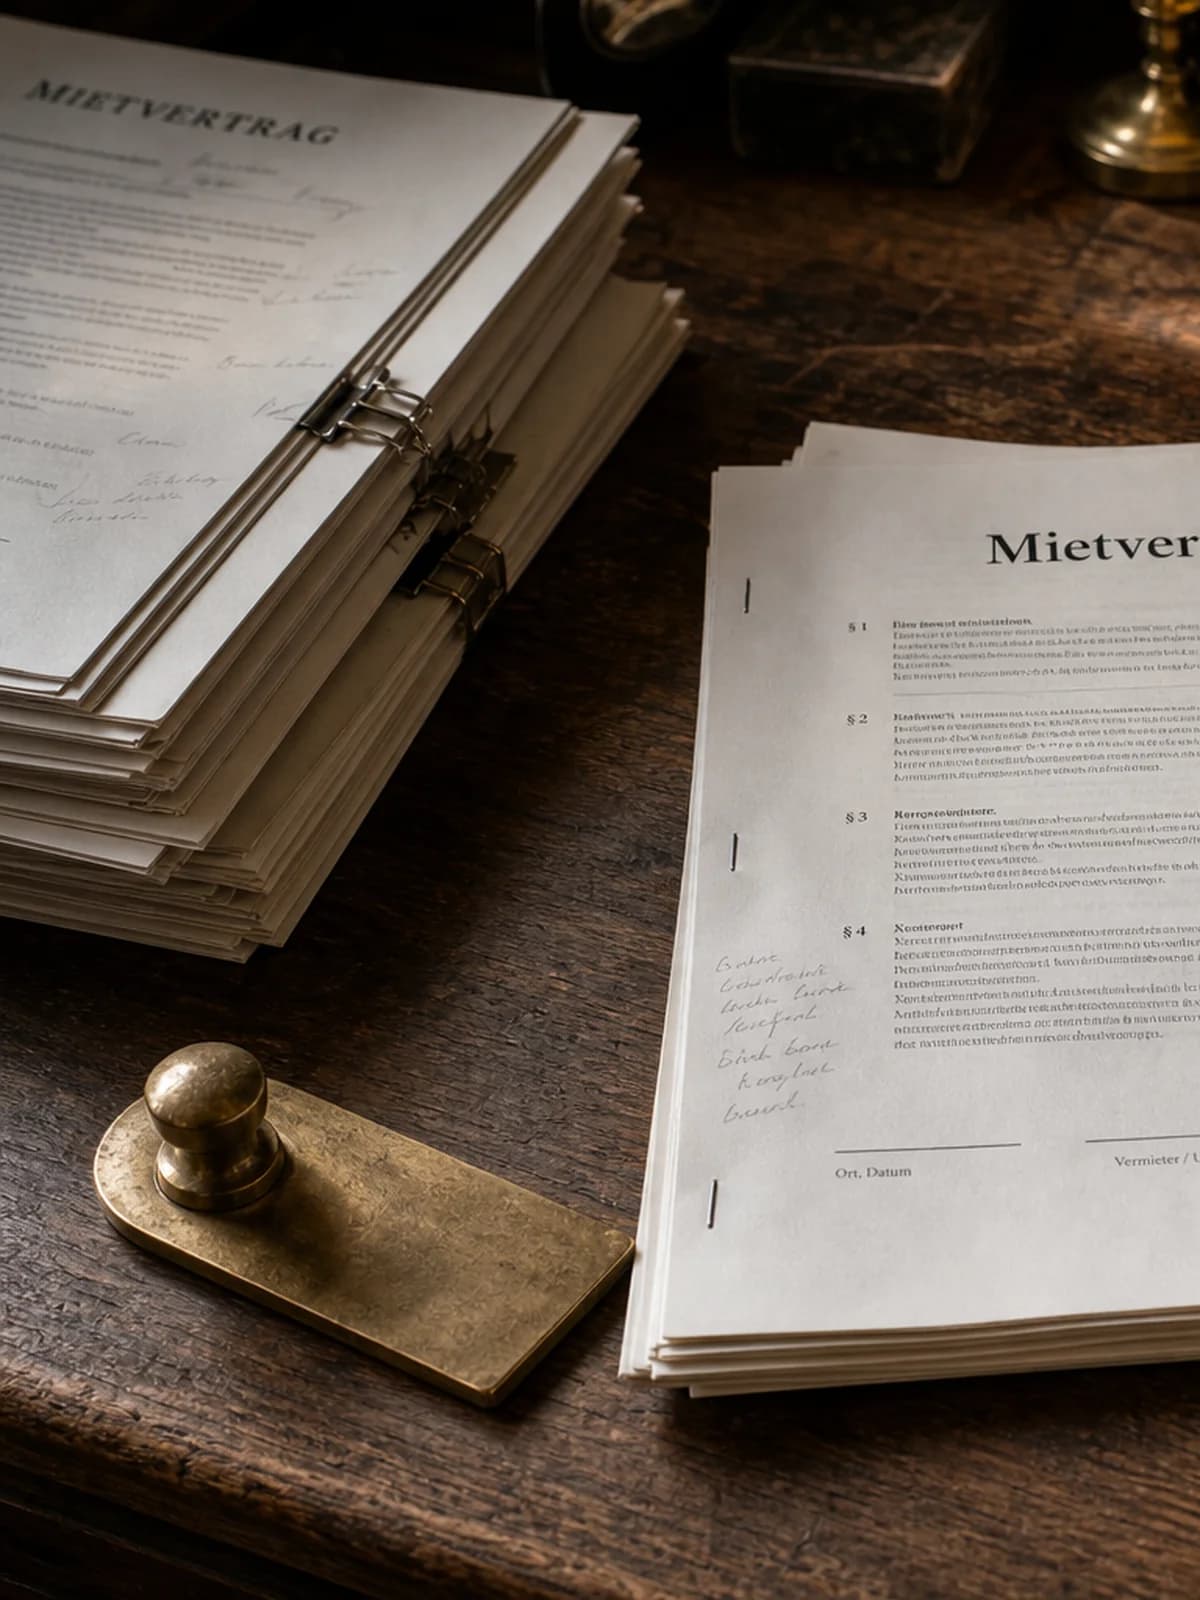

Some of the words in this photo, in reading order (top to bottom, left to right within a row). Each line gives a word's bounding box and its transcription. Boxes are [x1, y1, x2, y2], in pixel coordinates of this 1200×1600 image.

[24, 78, 339, 146] MIETVERTRAG
[861, 621, 867, 632] 1
[846, 714, 856, 727] §
[859, 713, 868, 724] 2
[845, 811, 855, 824] §
[857, 811, 868, 824] 3
[842, 925, 853, 940] §
[856, 925, 866, 937] 4
[1114, 1155, 1180, 1168] Vermieter
[1183, 1152, 1190, 1165] /
[834, 1167, 862, 1180] Ort,
[866, 1166, 913, 1179] Datum
